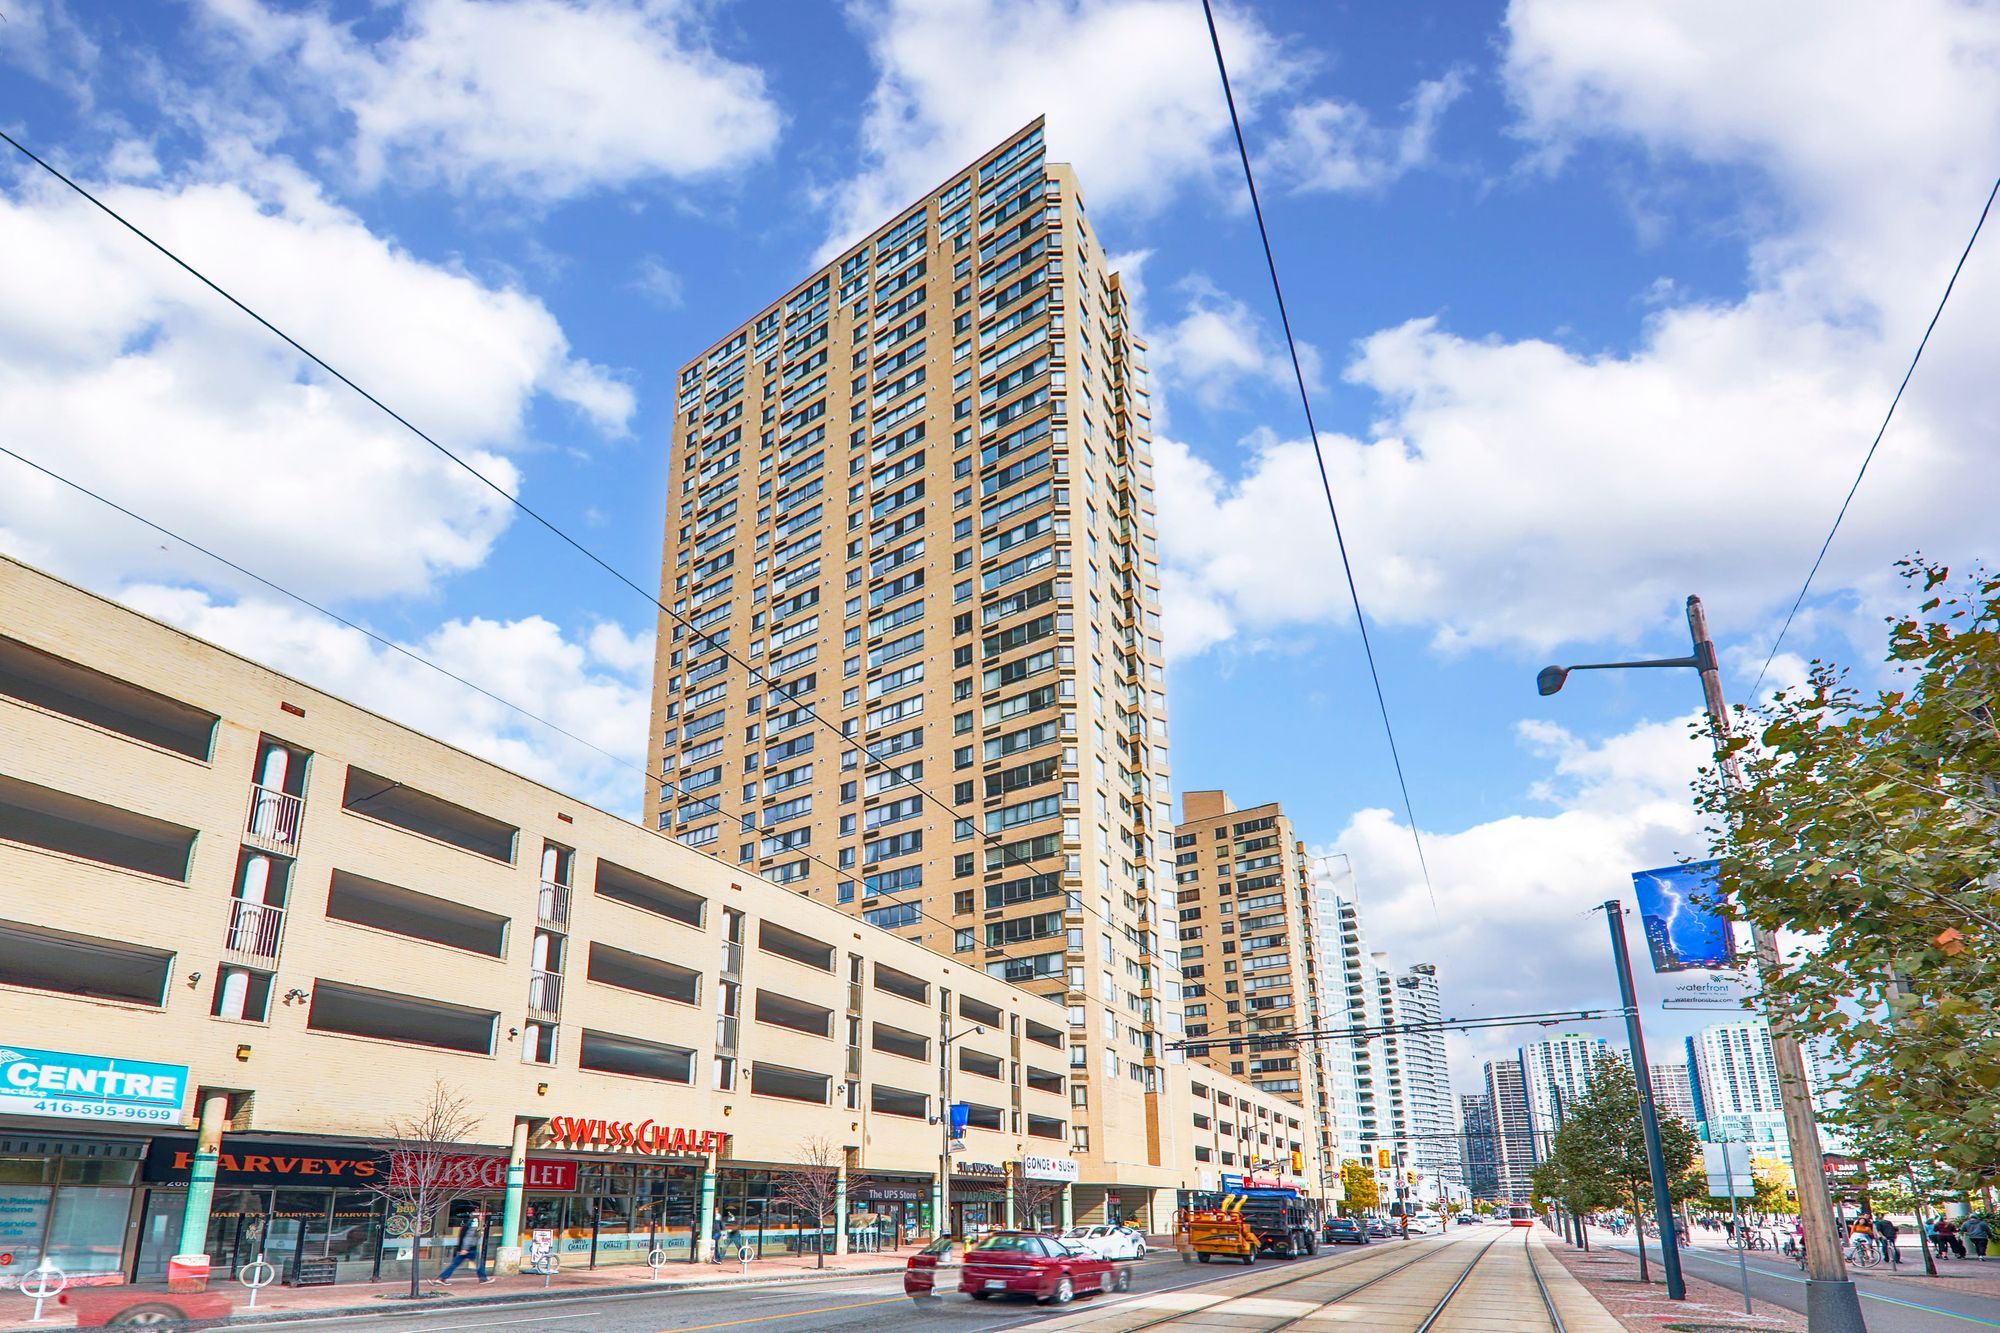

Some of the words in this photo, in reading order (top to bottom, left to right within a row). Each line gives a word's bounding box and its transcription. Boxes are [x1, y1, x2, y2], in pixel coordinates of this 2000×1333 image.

[1676, 983, 1729, 992] waterfront
[7, 1061, 177, 1099] CENTRE
[34, 1101, 171, 1120] 416-595-9699
[869, 1189, 882, 1198] The
[884, 1189, 898, 1199] UPS
[900, 1190, 917, 1199] Store
